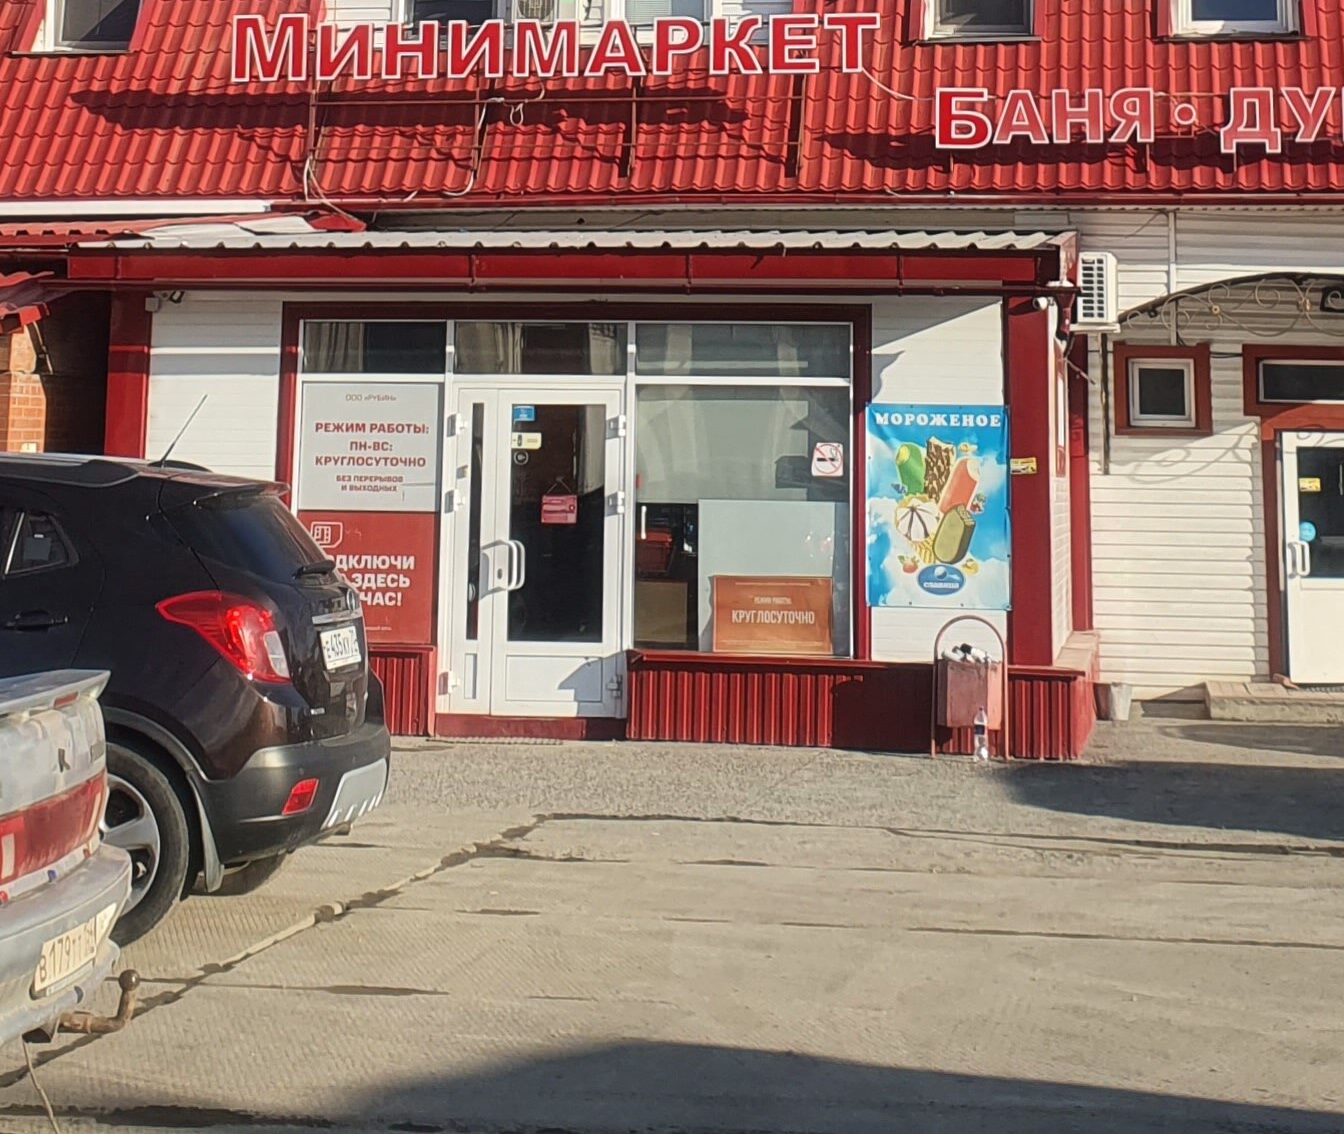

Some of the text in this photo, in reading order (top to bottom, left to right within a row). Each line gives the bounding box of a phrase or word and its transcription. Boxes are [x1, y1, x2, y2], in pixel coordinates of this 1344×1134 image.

[230, 11, 883, 85] МИНИМАРКЕТ
[934, 86, 1156, 150] БАНЯ
[874, 412, 1002, 428] МОРОЖЕНОЕ
[315, 422, 430, 434] РЕЖИМ РАБОТЫ:
[349, 441, 393, 452] ПН-ВС:
[315, 456, 426, 467] КРУГЛОСУТОЧНО
[353, 475, 403, 483] ПЕРЕРЫВОВ
[349, 485, 397, 493] ВЫХОДНЫХ
[351, 573, 411, 590] ЗДЕСЬ
[731, 609, 815, 625] КРУГЛОСУТОЧНО
